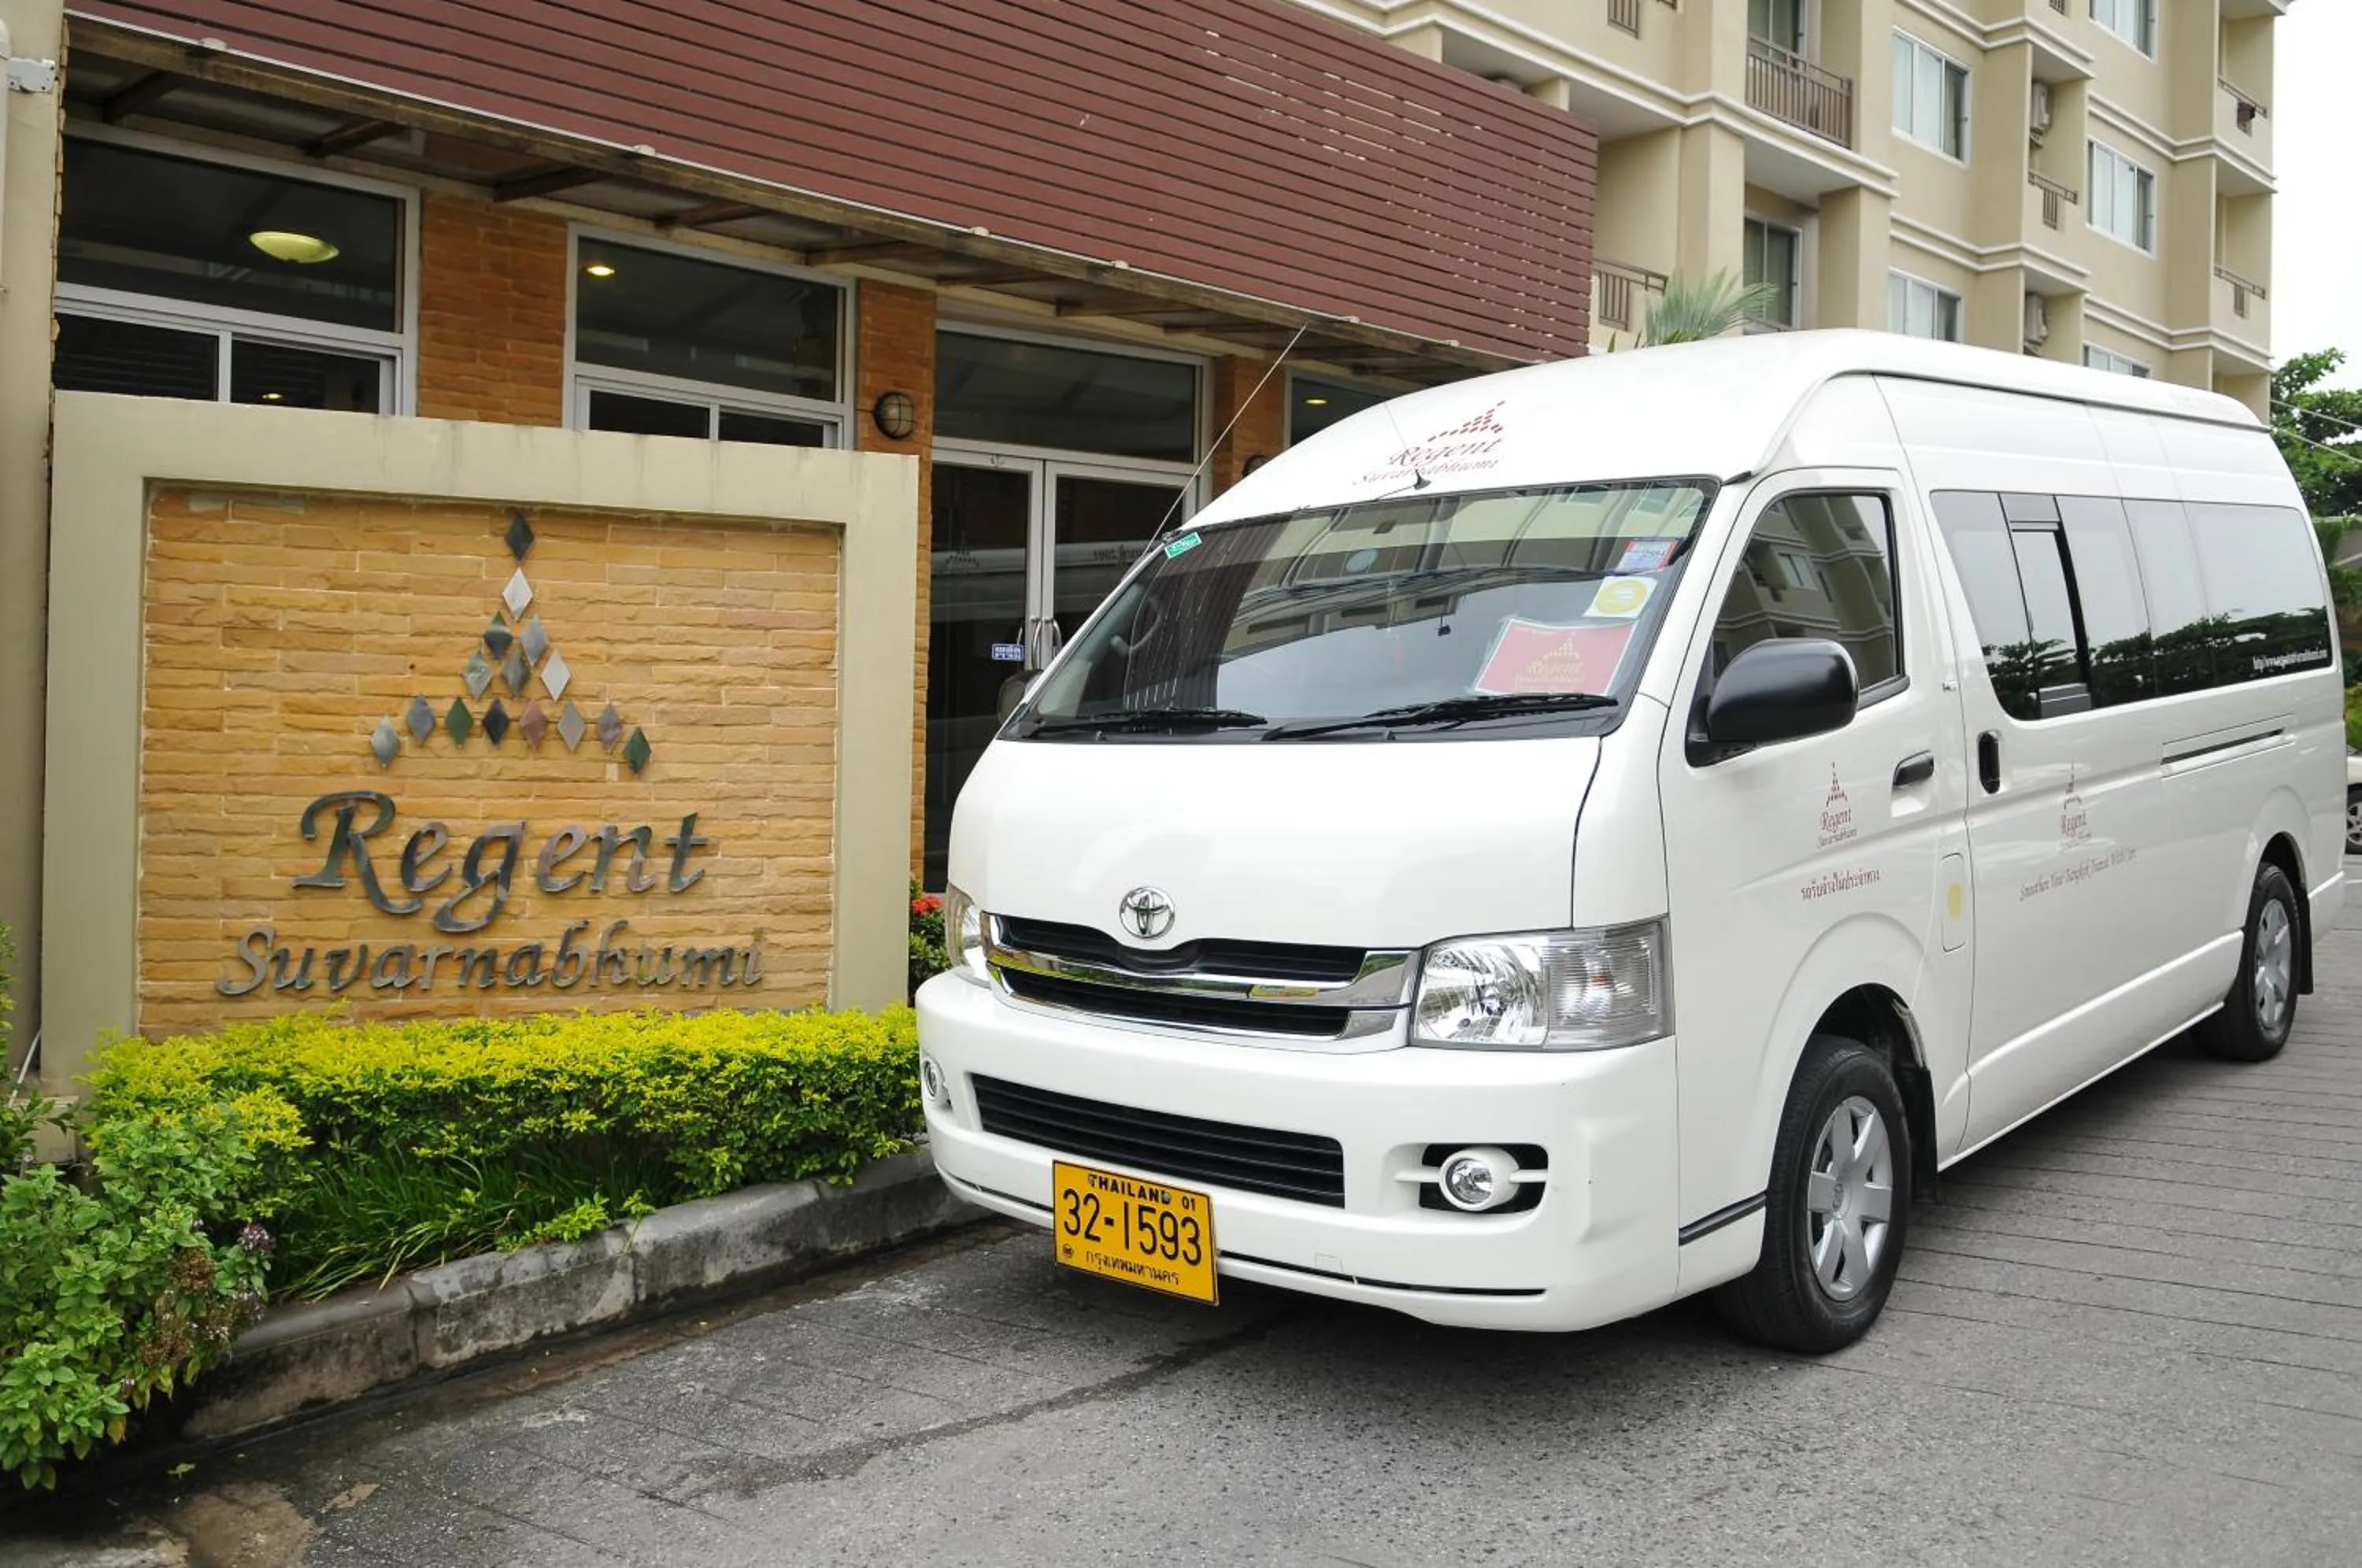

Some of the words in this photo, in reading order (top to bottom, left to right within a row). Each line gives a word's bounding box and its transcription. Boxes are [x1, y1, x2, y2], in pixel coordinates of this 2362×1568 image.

[1387, 438, 1502, 467] Regent
[291, 790, 707, 933] Regent
[214, 918, 766, 996] Suvarnabhumi
[1088, 1174, 1172, 1205] THAILAND
[1182, 1195, 1196, 1211] 01
[1063, 1188, 1202, 1266] 32-1593
[1086, 1250, 1179, 1285] กรุงเทพมหานคร
